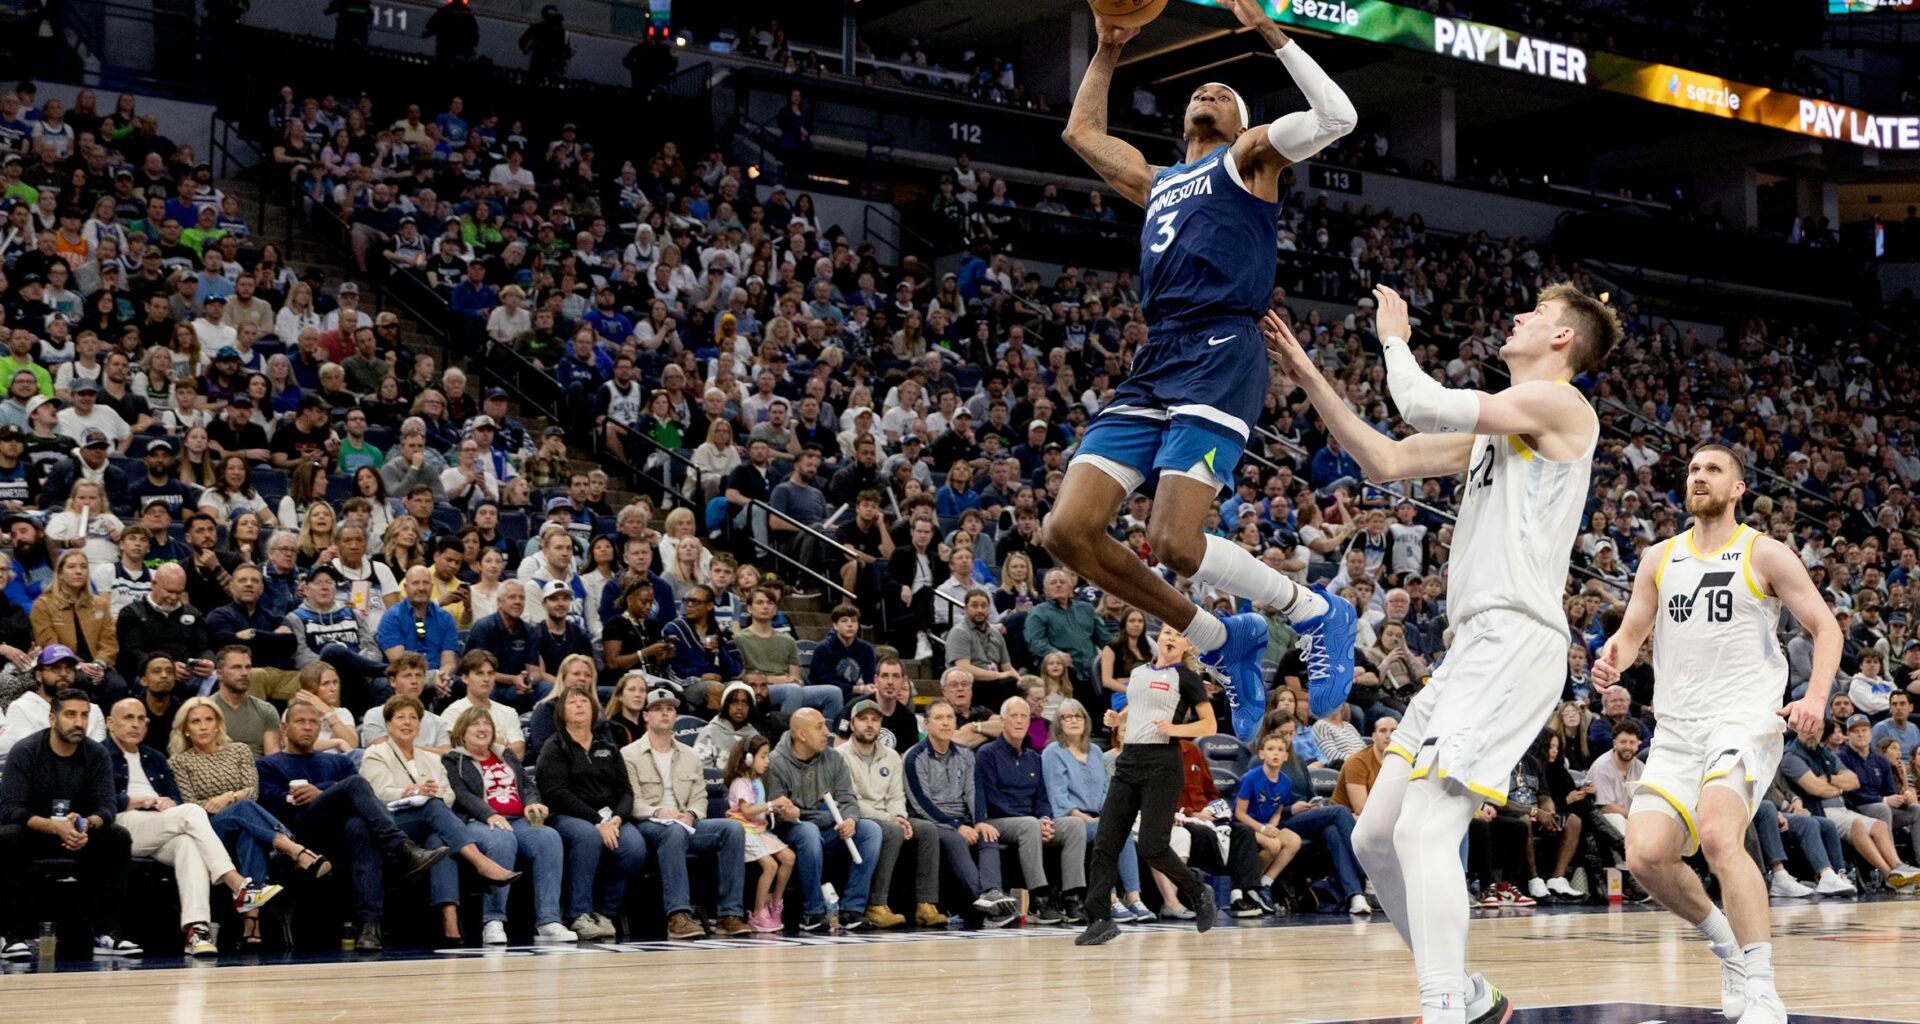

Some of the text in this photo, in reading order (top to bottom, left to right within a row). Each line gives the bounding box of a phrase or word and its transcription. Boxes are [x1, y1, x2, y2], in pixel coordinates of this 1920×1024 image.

[372, 5, 407, 30] 111
[1292, 0, 1359, 27] sezzle
[1434, 16, 1587, 85] PAY LATER
[1686, 82, 1740, 110] sezzle
[949, 121, 982, 144] 112
[1799, 99, 1920, 149] PAY LATE
[1324, 170, 1350, 190] 113
[1150, 209, 1179, 253] 3
[1721, 552, 1742, 560] LVT
[1704, 589, 1733, 622] 19
